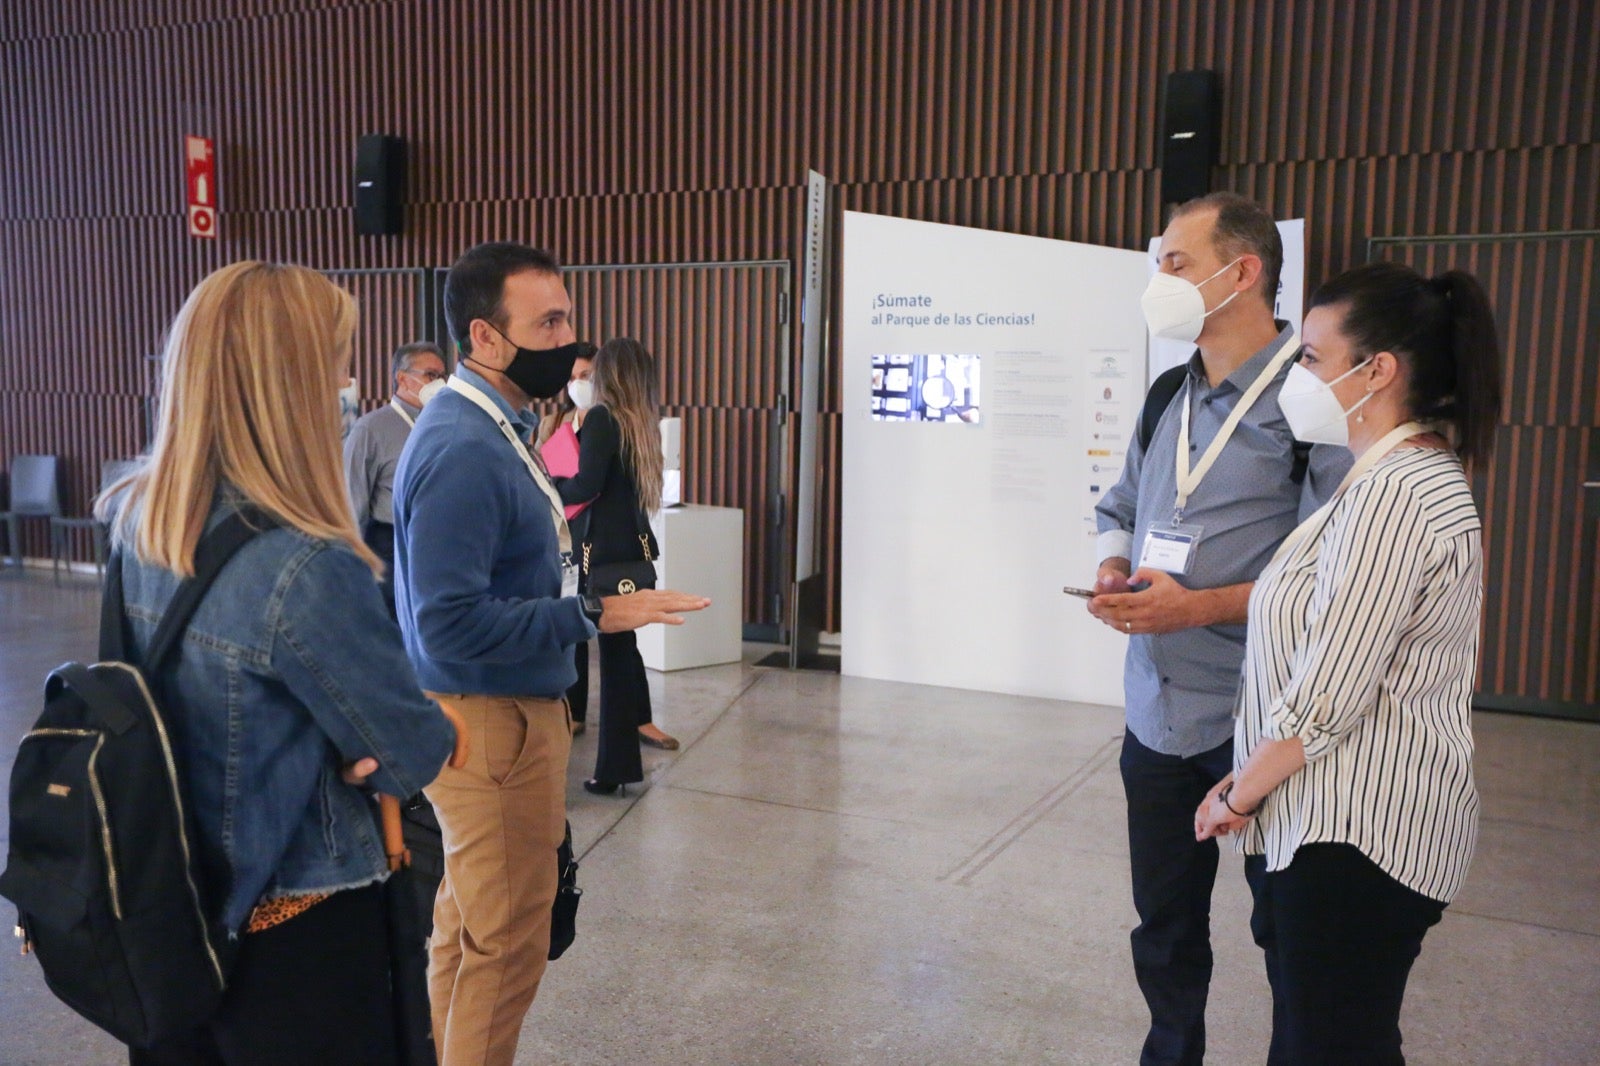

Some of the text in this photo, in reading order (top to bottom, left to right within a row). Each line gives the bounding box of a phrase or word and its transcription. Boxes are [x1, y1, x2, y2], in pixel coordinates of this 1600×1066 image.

[872, 293, 932, 309] ¡Súmate
[871, 312, 1035, 328] al Parque de las Ciencias!
